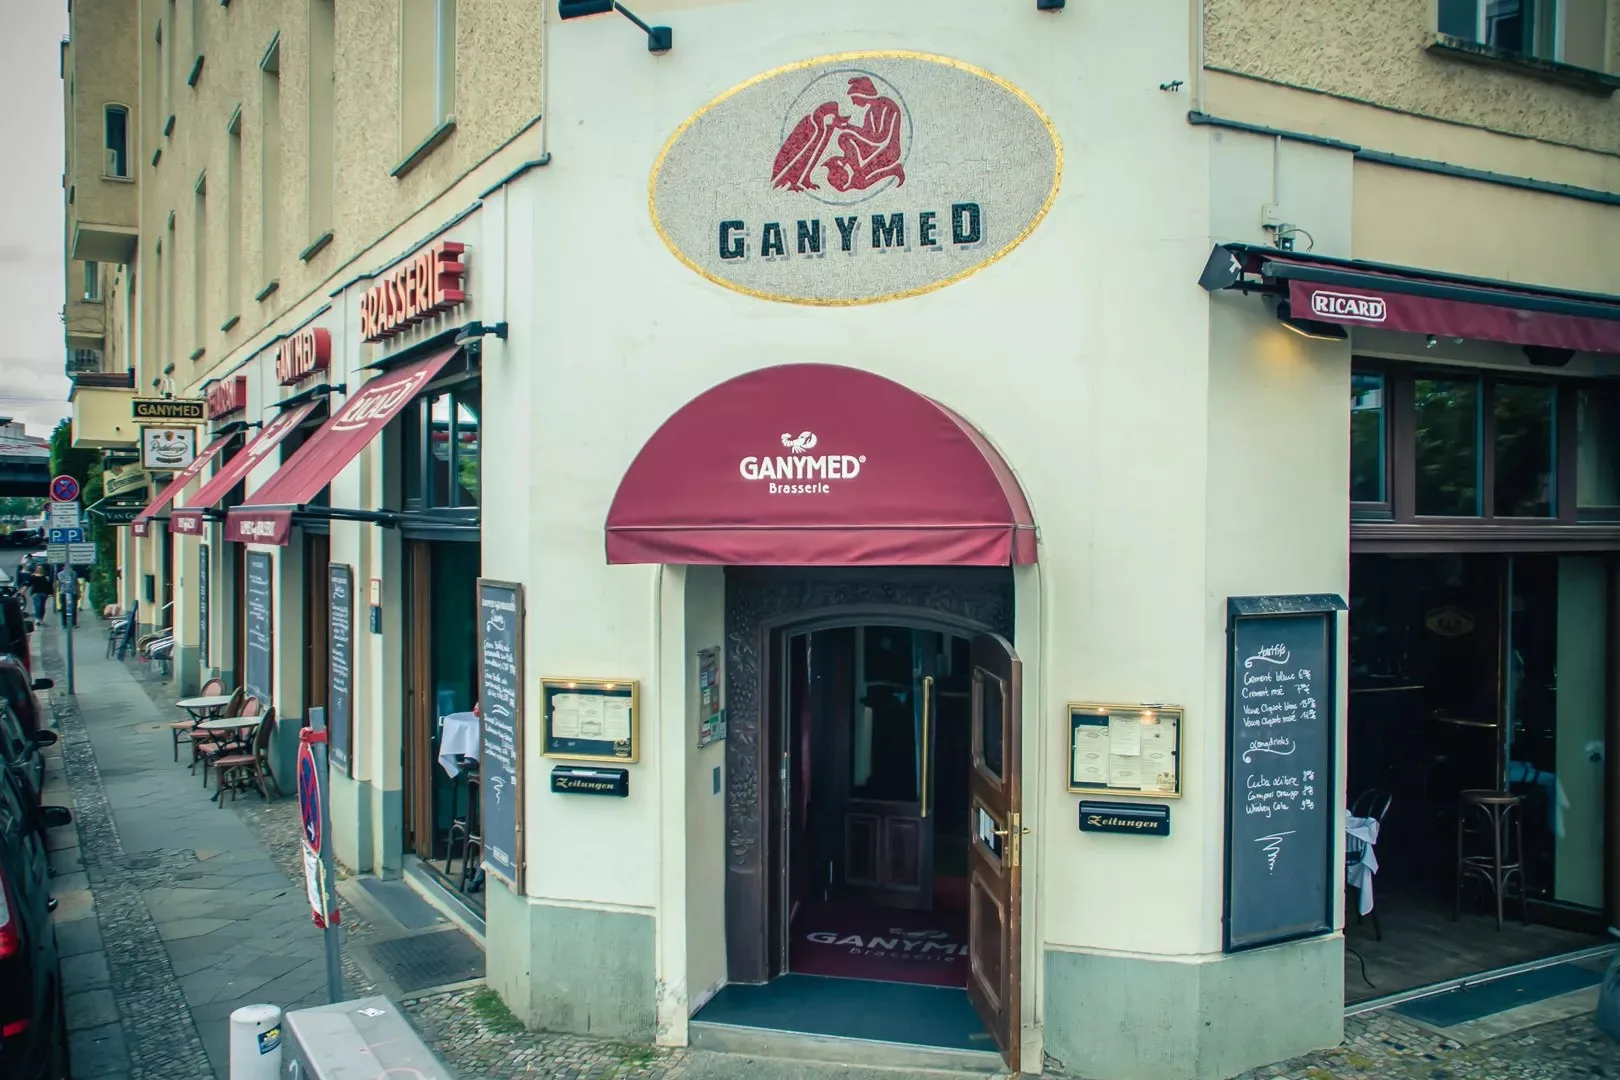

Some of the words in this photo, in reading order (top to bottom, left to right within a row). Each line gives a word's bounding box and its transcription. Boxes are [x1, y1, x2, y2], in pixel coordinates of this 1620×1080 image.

[719, 202, 984, 260] GANYMED
[360, 241, 464, 343] BRASSERIE
[1315, 295, 1383, 318] RICARD
[137, 404, 200, 417] GANYMED
[769, 482, 830, 494] Brasserie
[556, 777, 615, 790] Zeitungen
[1087, 815, 1158, 829] Zeitungen
